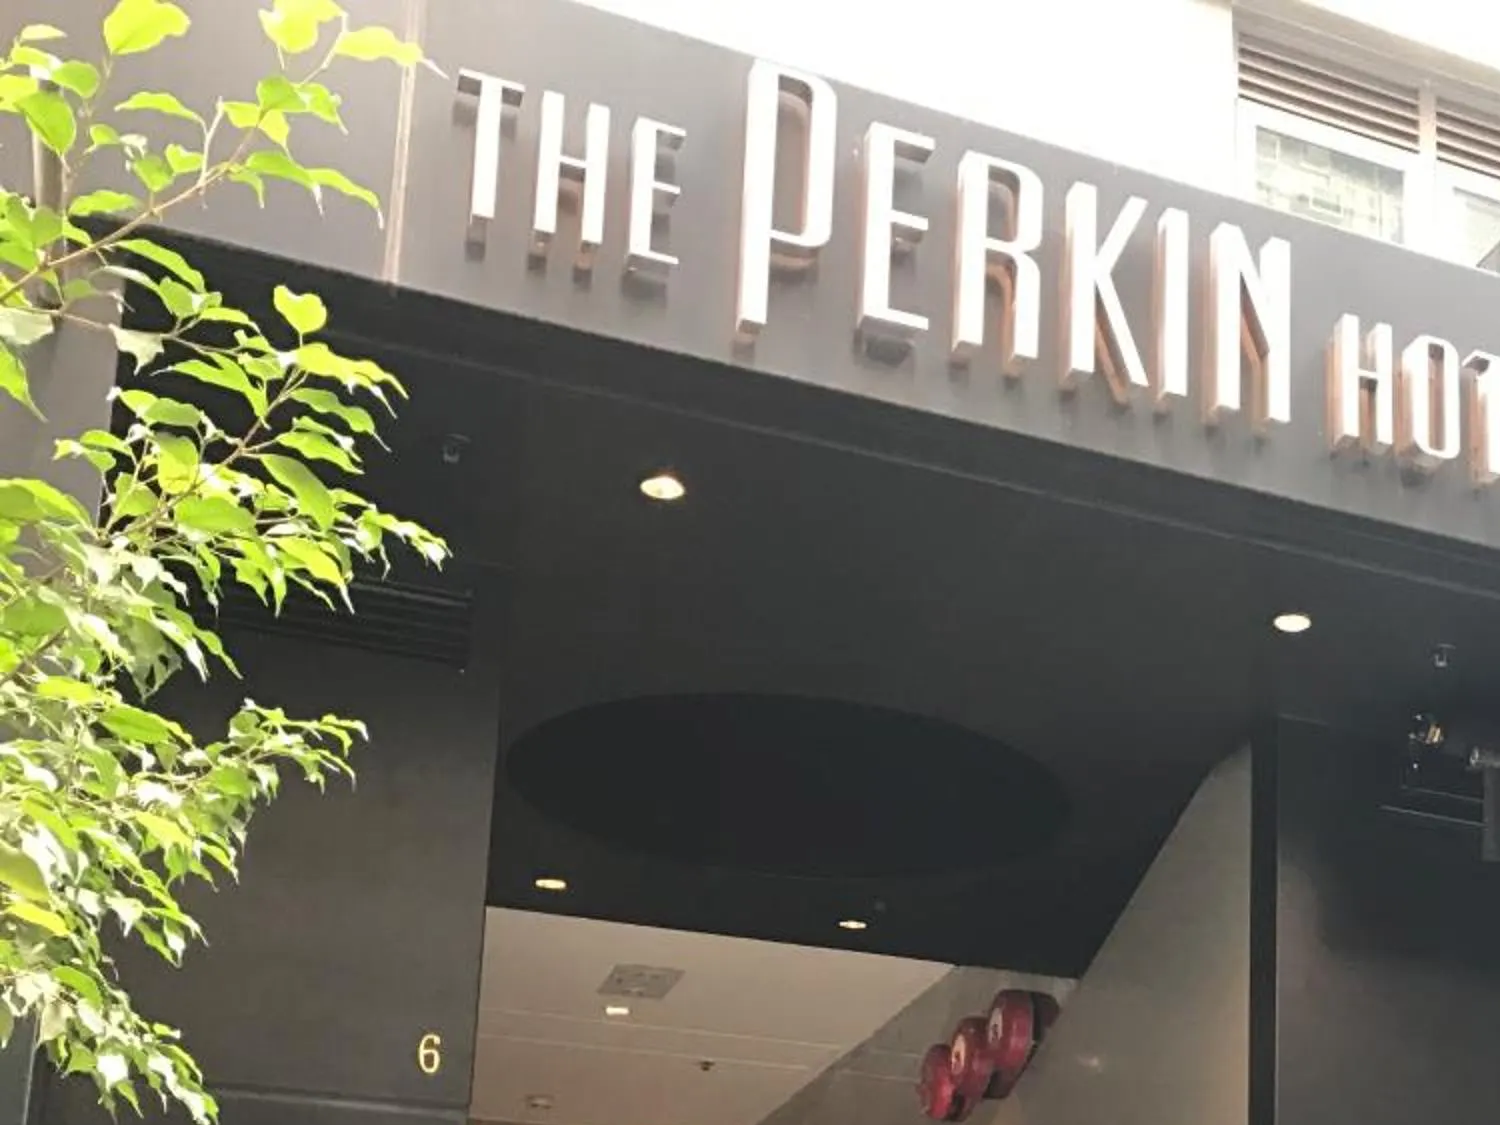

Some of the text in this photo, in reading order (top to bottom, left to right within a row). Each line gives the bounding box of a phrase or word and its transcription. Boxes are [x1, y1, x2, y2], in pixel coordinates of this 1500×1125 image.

[457, 66, 687, 269] THE
[736, 57, 1291, 425] PERKIN
[419, 1033, 441, 1074] 6
